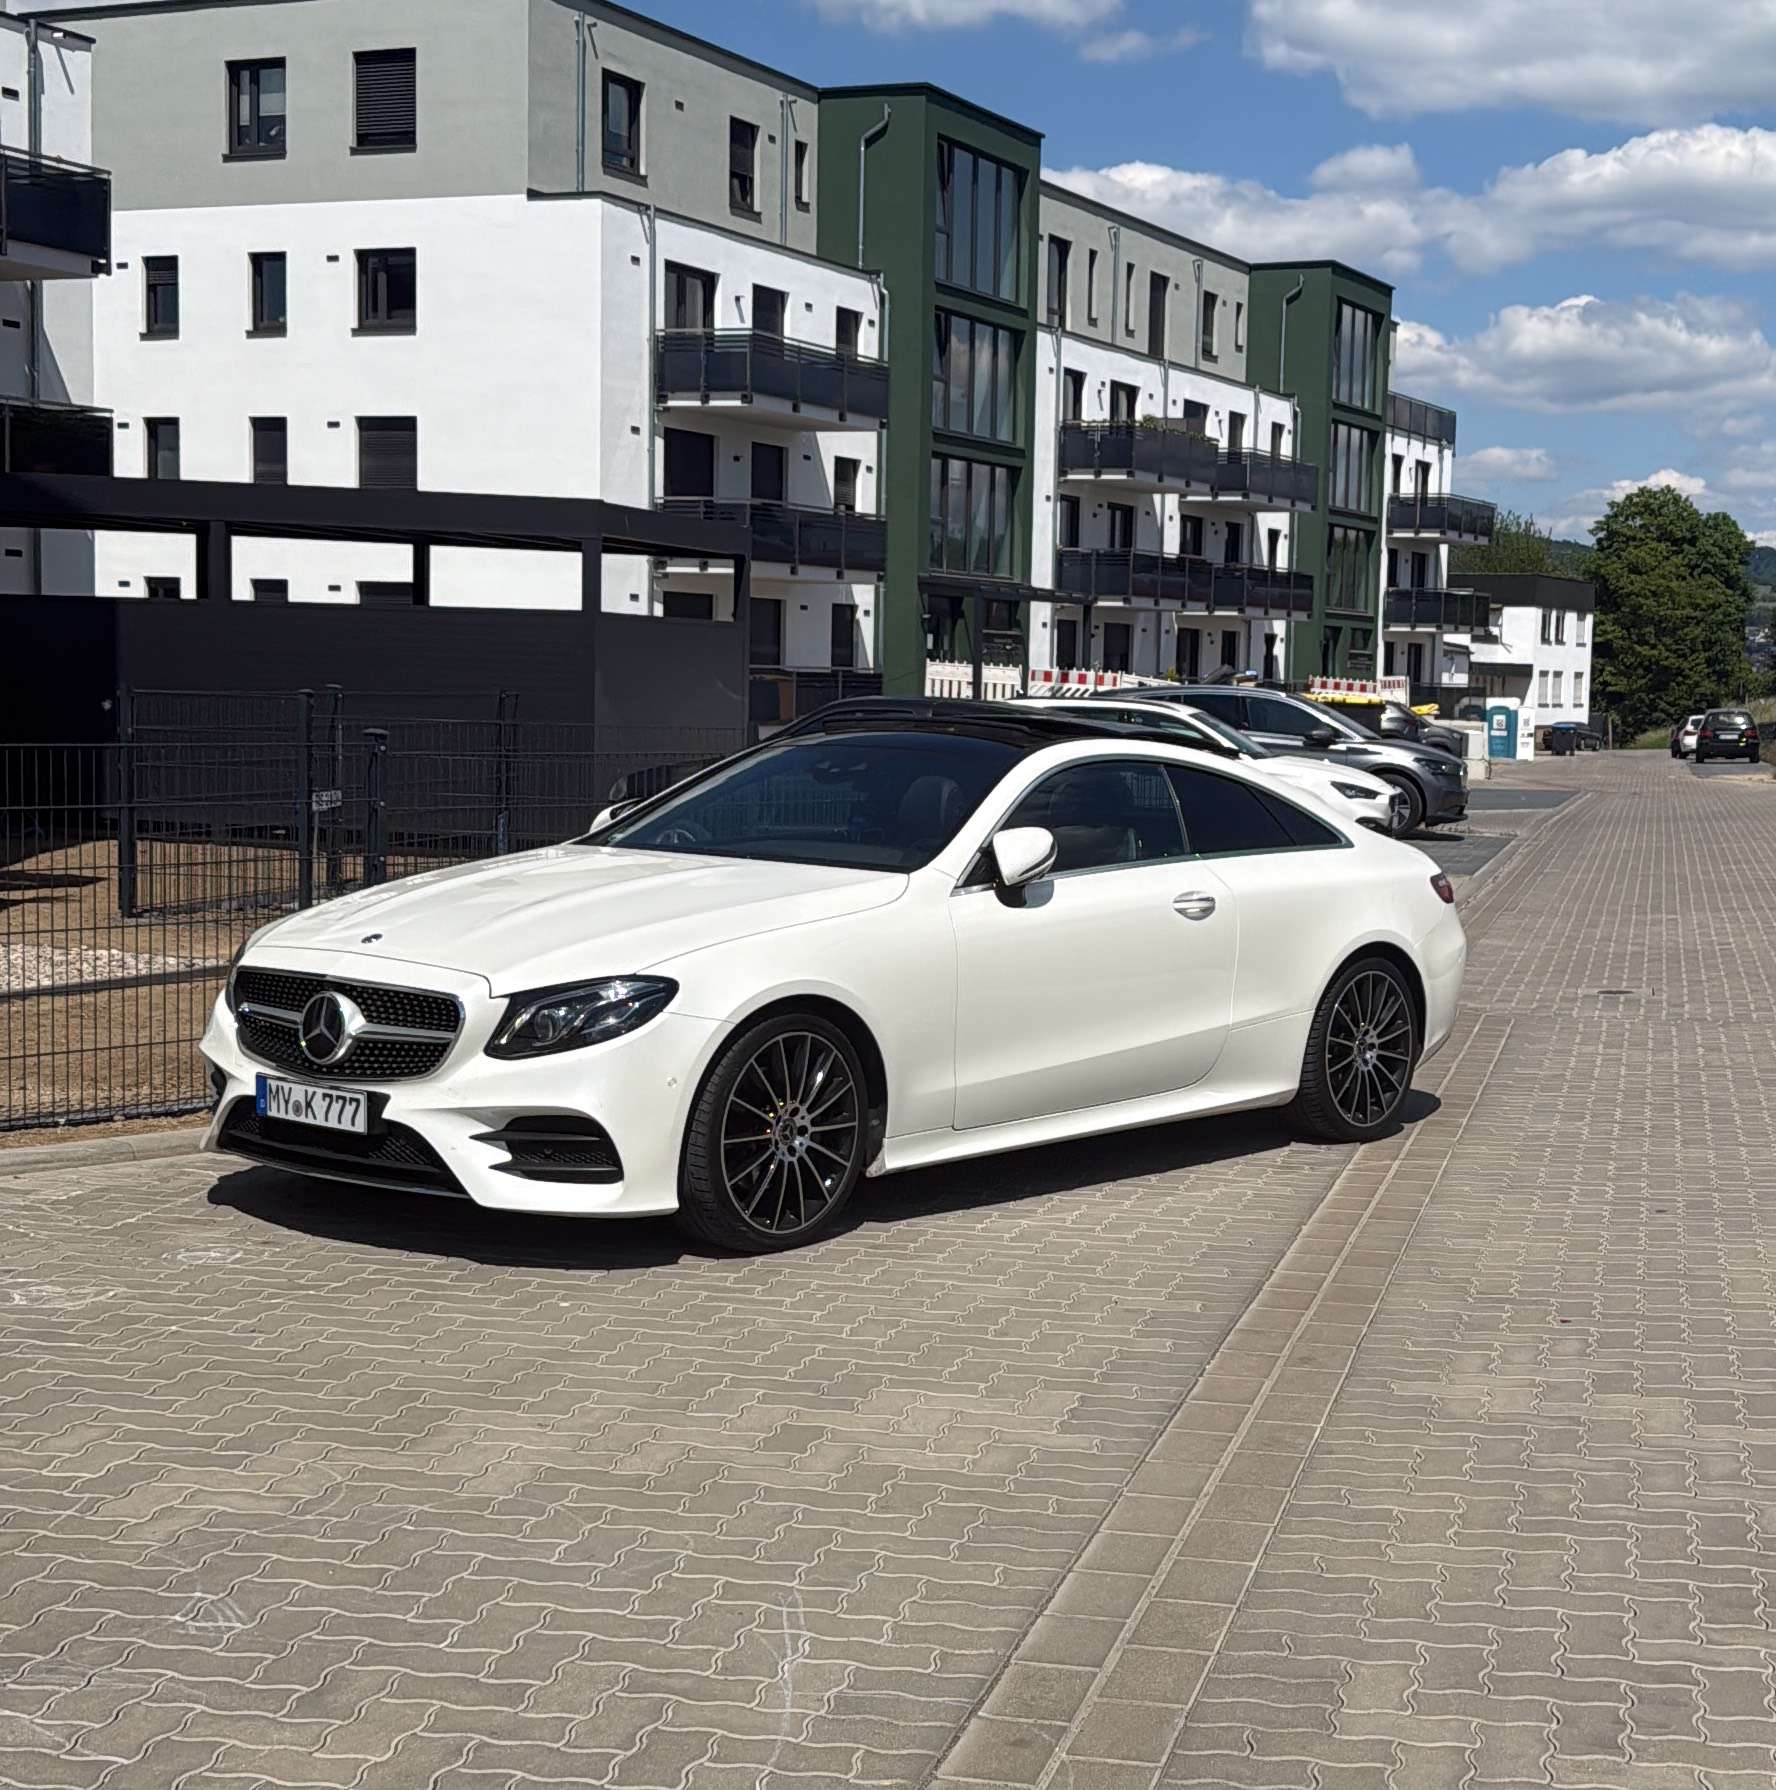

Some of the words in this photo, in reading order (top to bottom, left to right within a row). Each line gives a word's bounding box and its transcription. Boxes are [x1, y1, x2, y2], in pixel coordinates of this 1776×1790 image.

[268, 1083, 293, 1116] MY
[304, 1089, 318, 1121] K
[321, 1092, 361, 1127] 777
